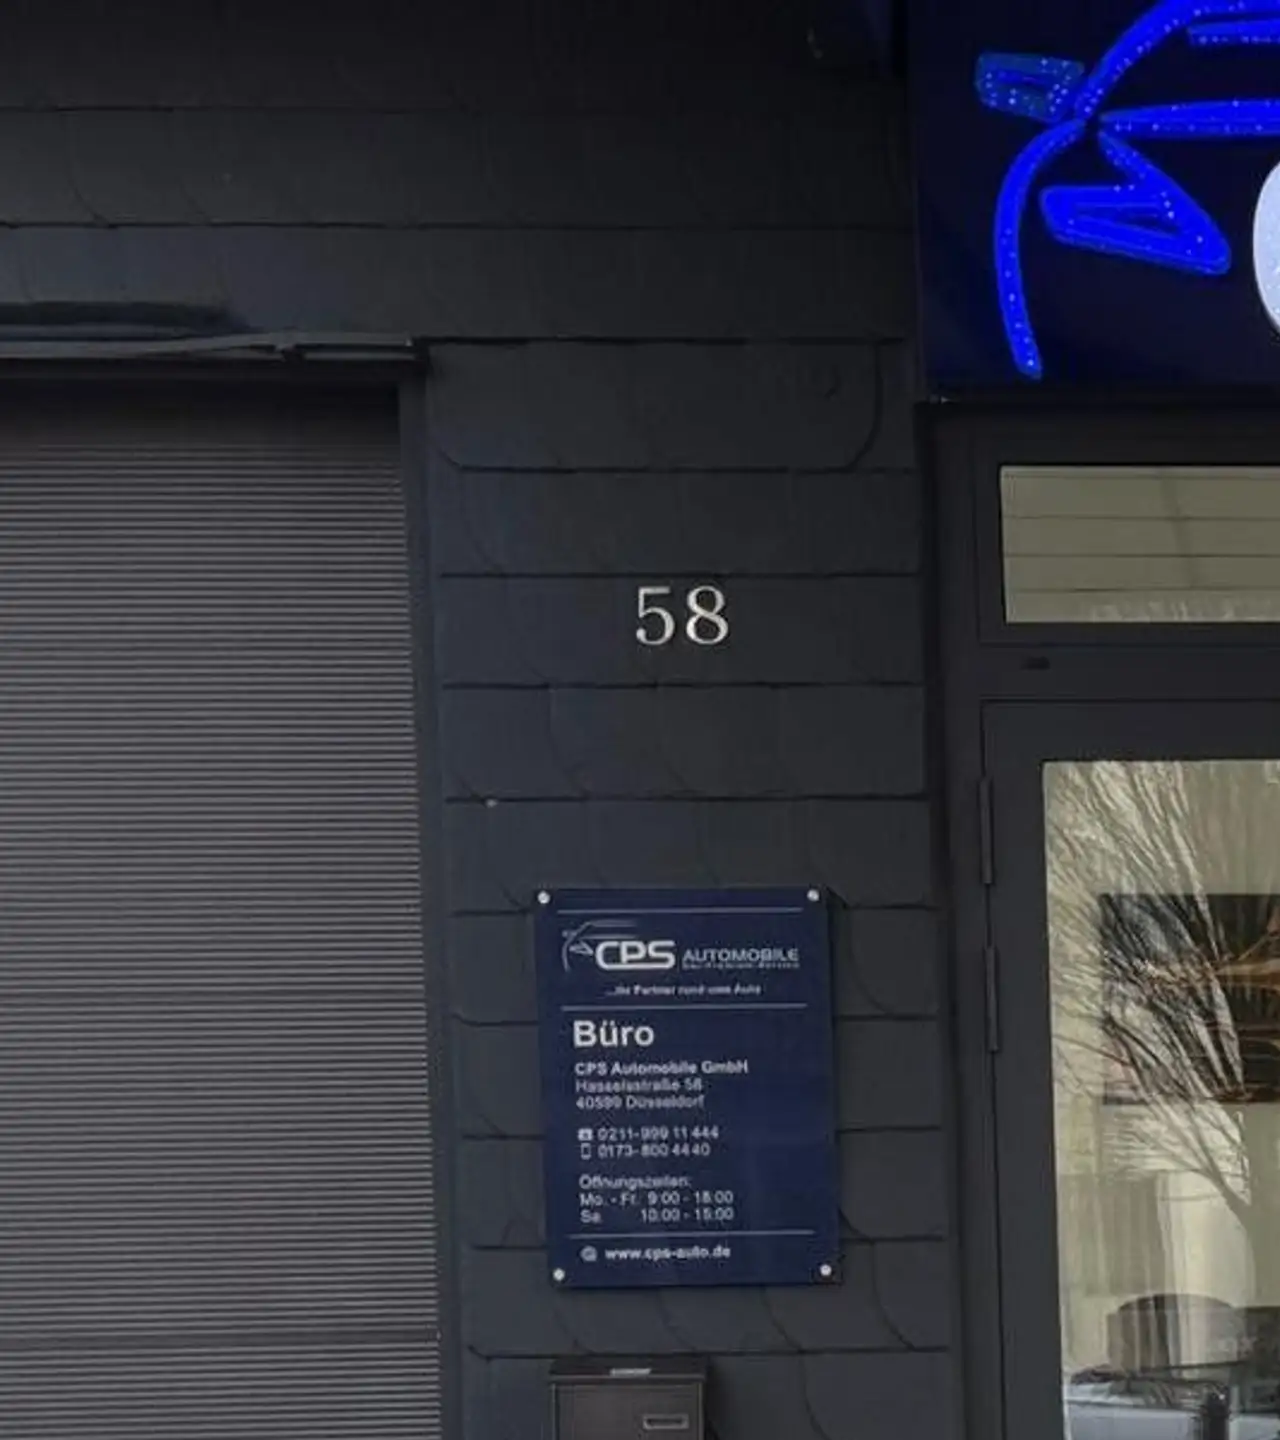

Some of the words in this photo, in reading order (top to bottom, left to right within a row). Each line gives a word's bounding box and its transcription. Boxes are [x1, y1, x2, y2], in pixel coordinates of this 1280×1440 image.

[636, 585, 729, 645] 58
[595, 940, 677, 971] CPS
[682, 948, 800, 962] AUTOMOBILE
[573, 1020, 655, 1048] Büro
[574, 1061, 607, 1076] CPS
[611, 1061, 698, 1075] Automobile
[701, 1059, 749, 1075] GmbH
[604, 1245, 732, 1262] www.cps-auto.de
